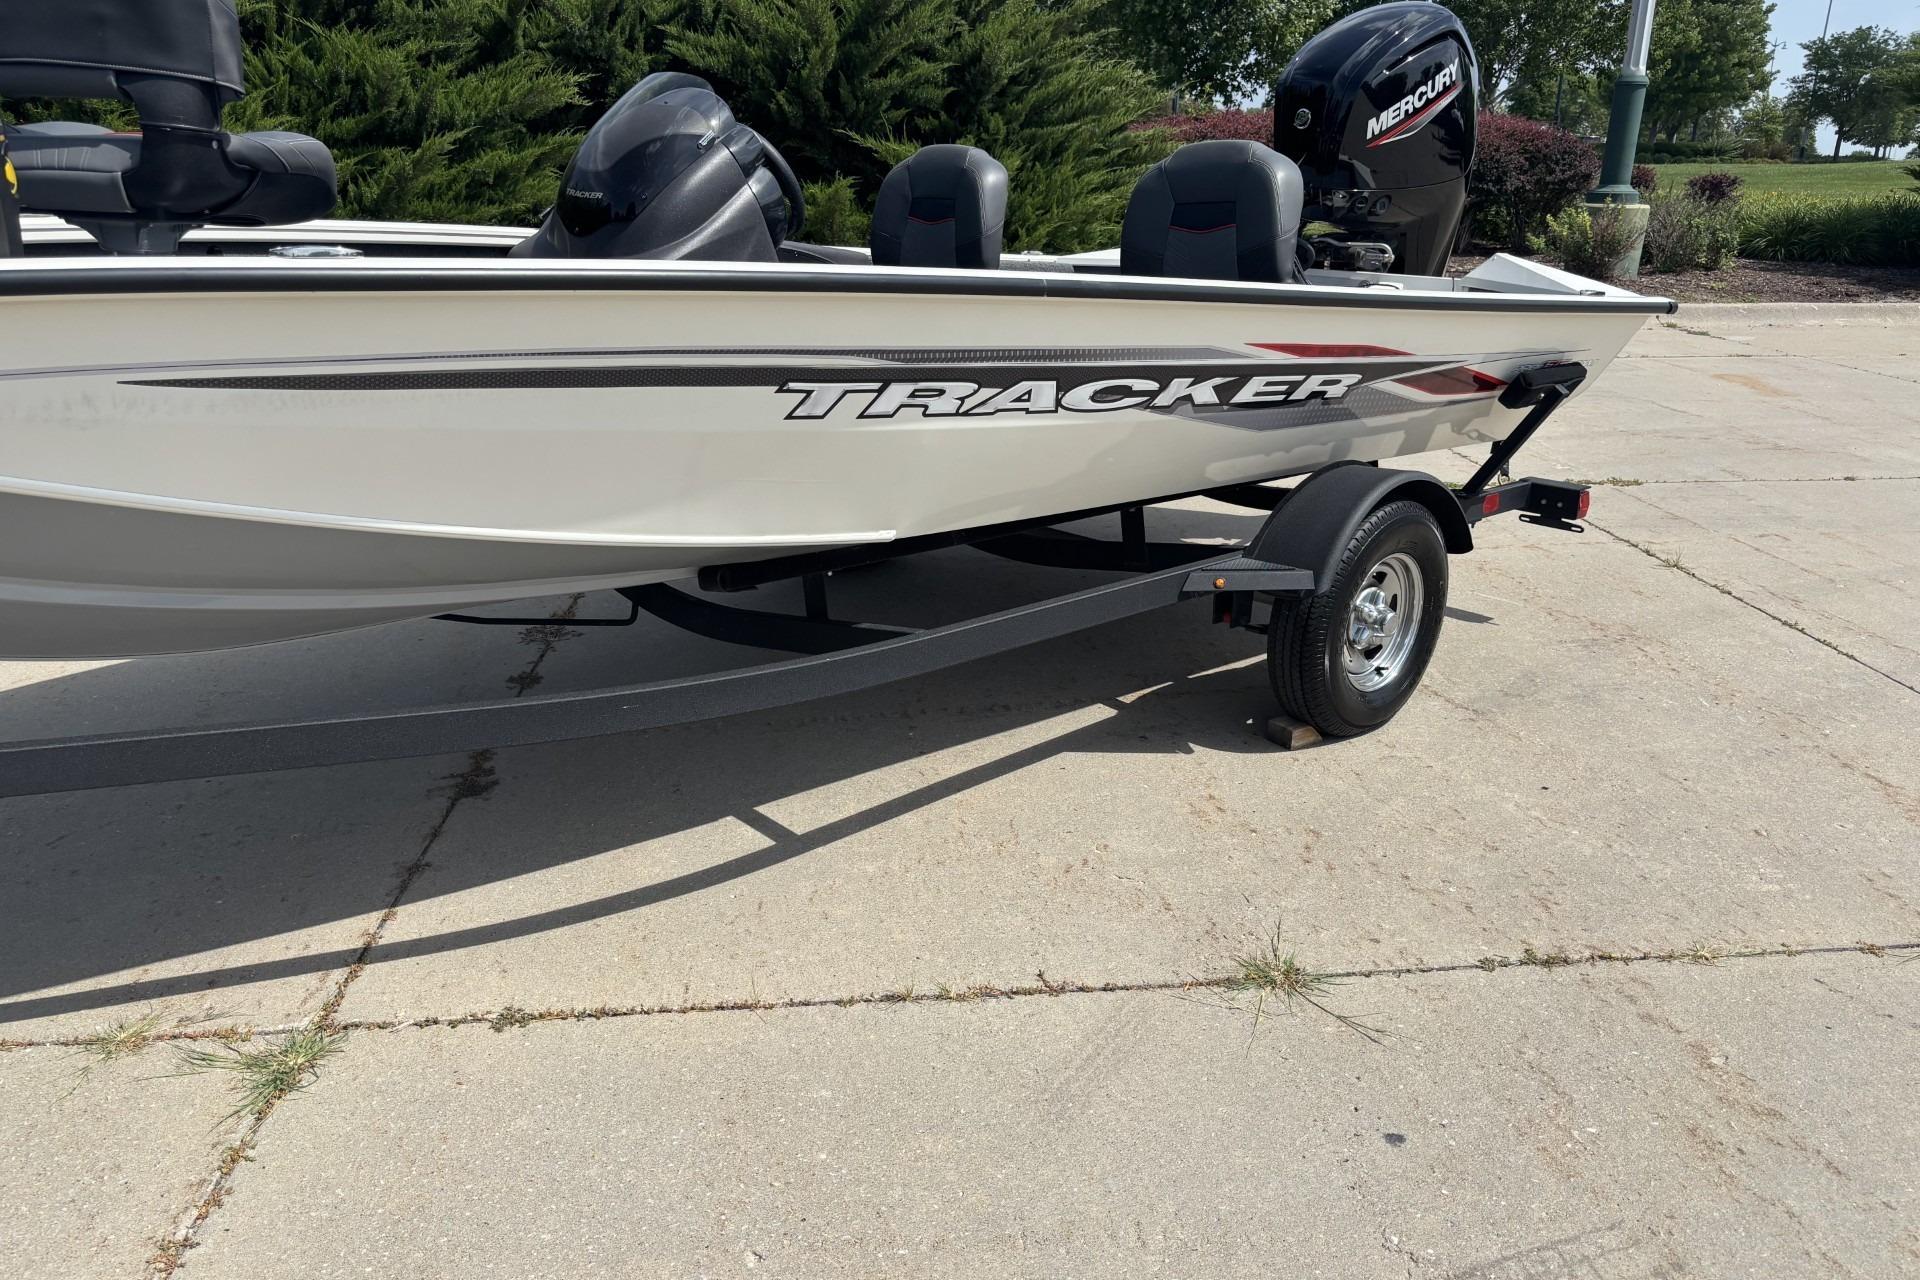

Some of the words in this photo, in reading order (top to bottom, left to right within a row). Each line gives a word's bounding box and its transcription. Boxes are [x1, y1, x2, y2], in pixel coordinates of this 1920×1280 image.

[1367, 57, 1459, 140] MERCURY
[566, 188, 604, 199] TRACKER
[776, 373, 1363, 420] TRACKER
